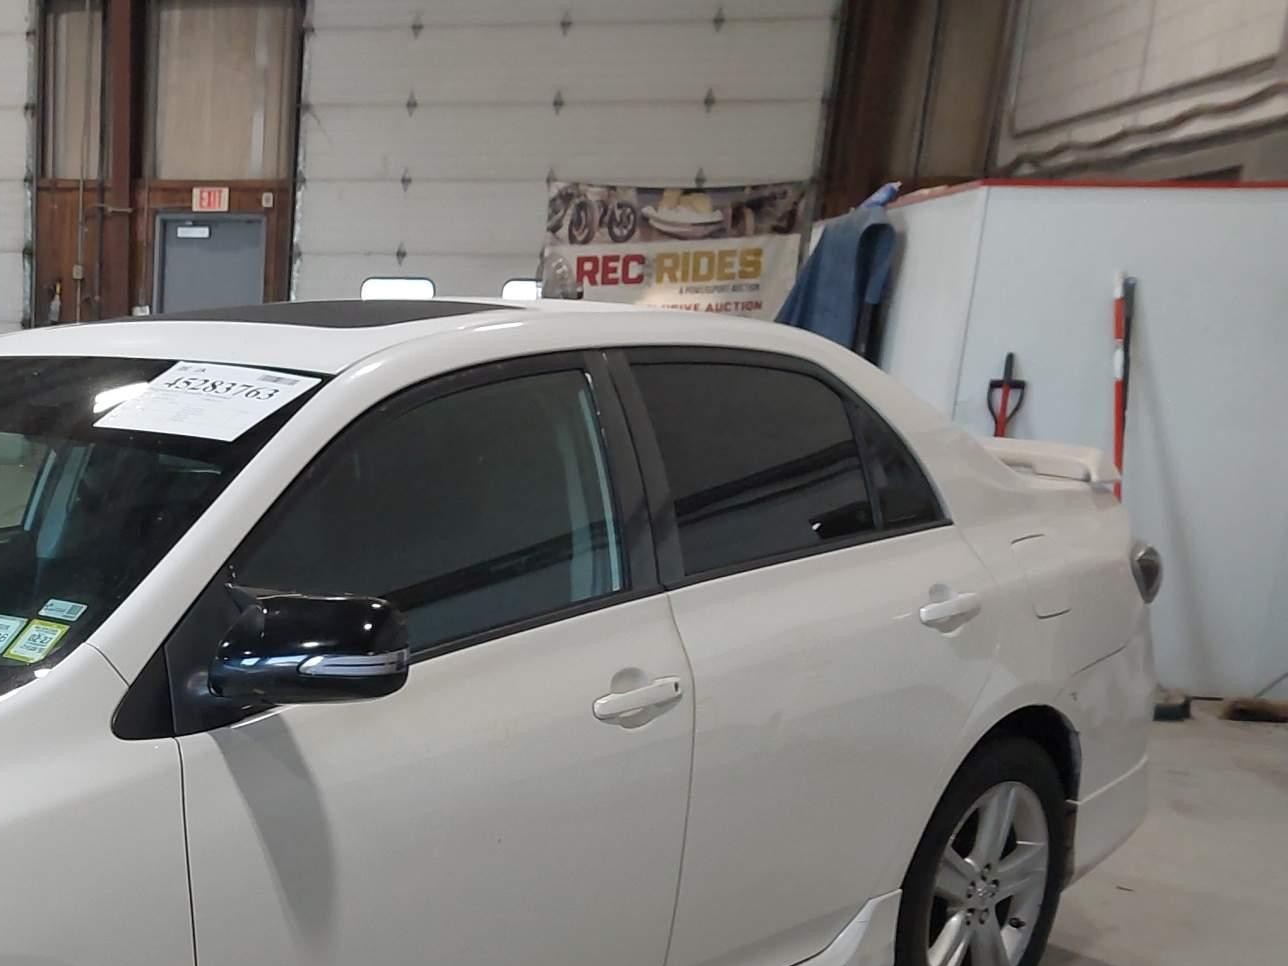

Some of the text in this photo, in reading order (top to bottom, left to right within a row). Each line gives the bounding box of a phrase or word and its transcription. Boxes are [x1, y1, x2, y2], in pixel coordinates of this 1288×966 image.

[576, 247, 763, 287] REC RIDES
[704, 300, 762, 313] AUCTION
[164, 375, 280, 401] 45283763
